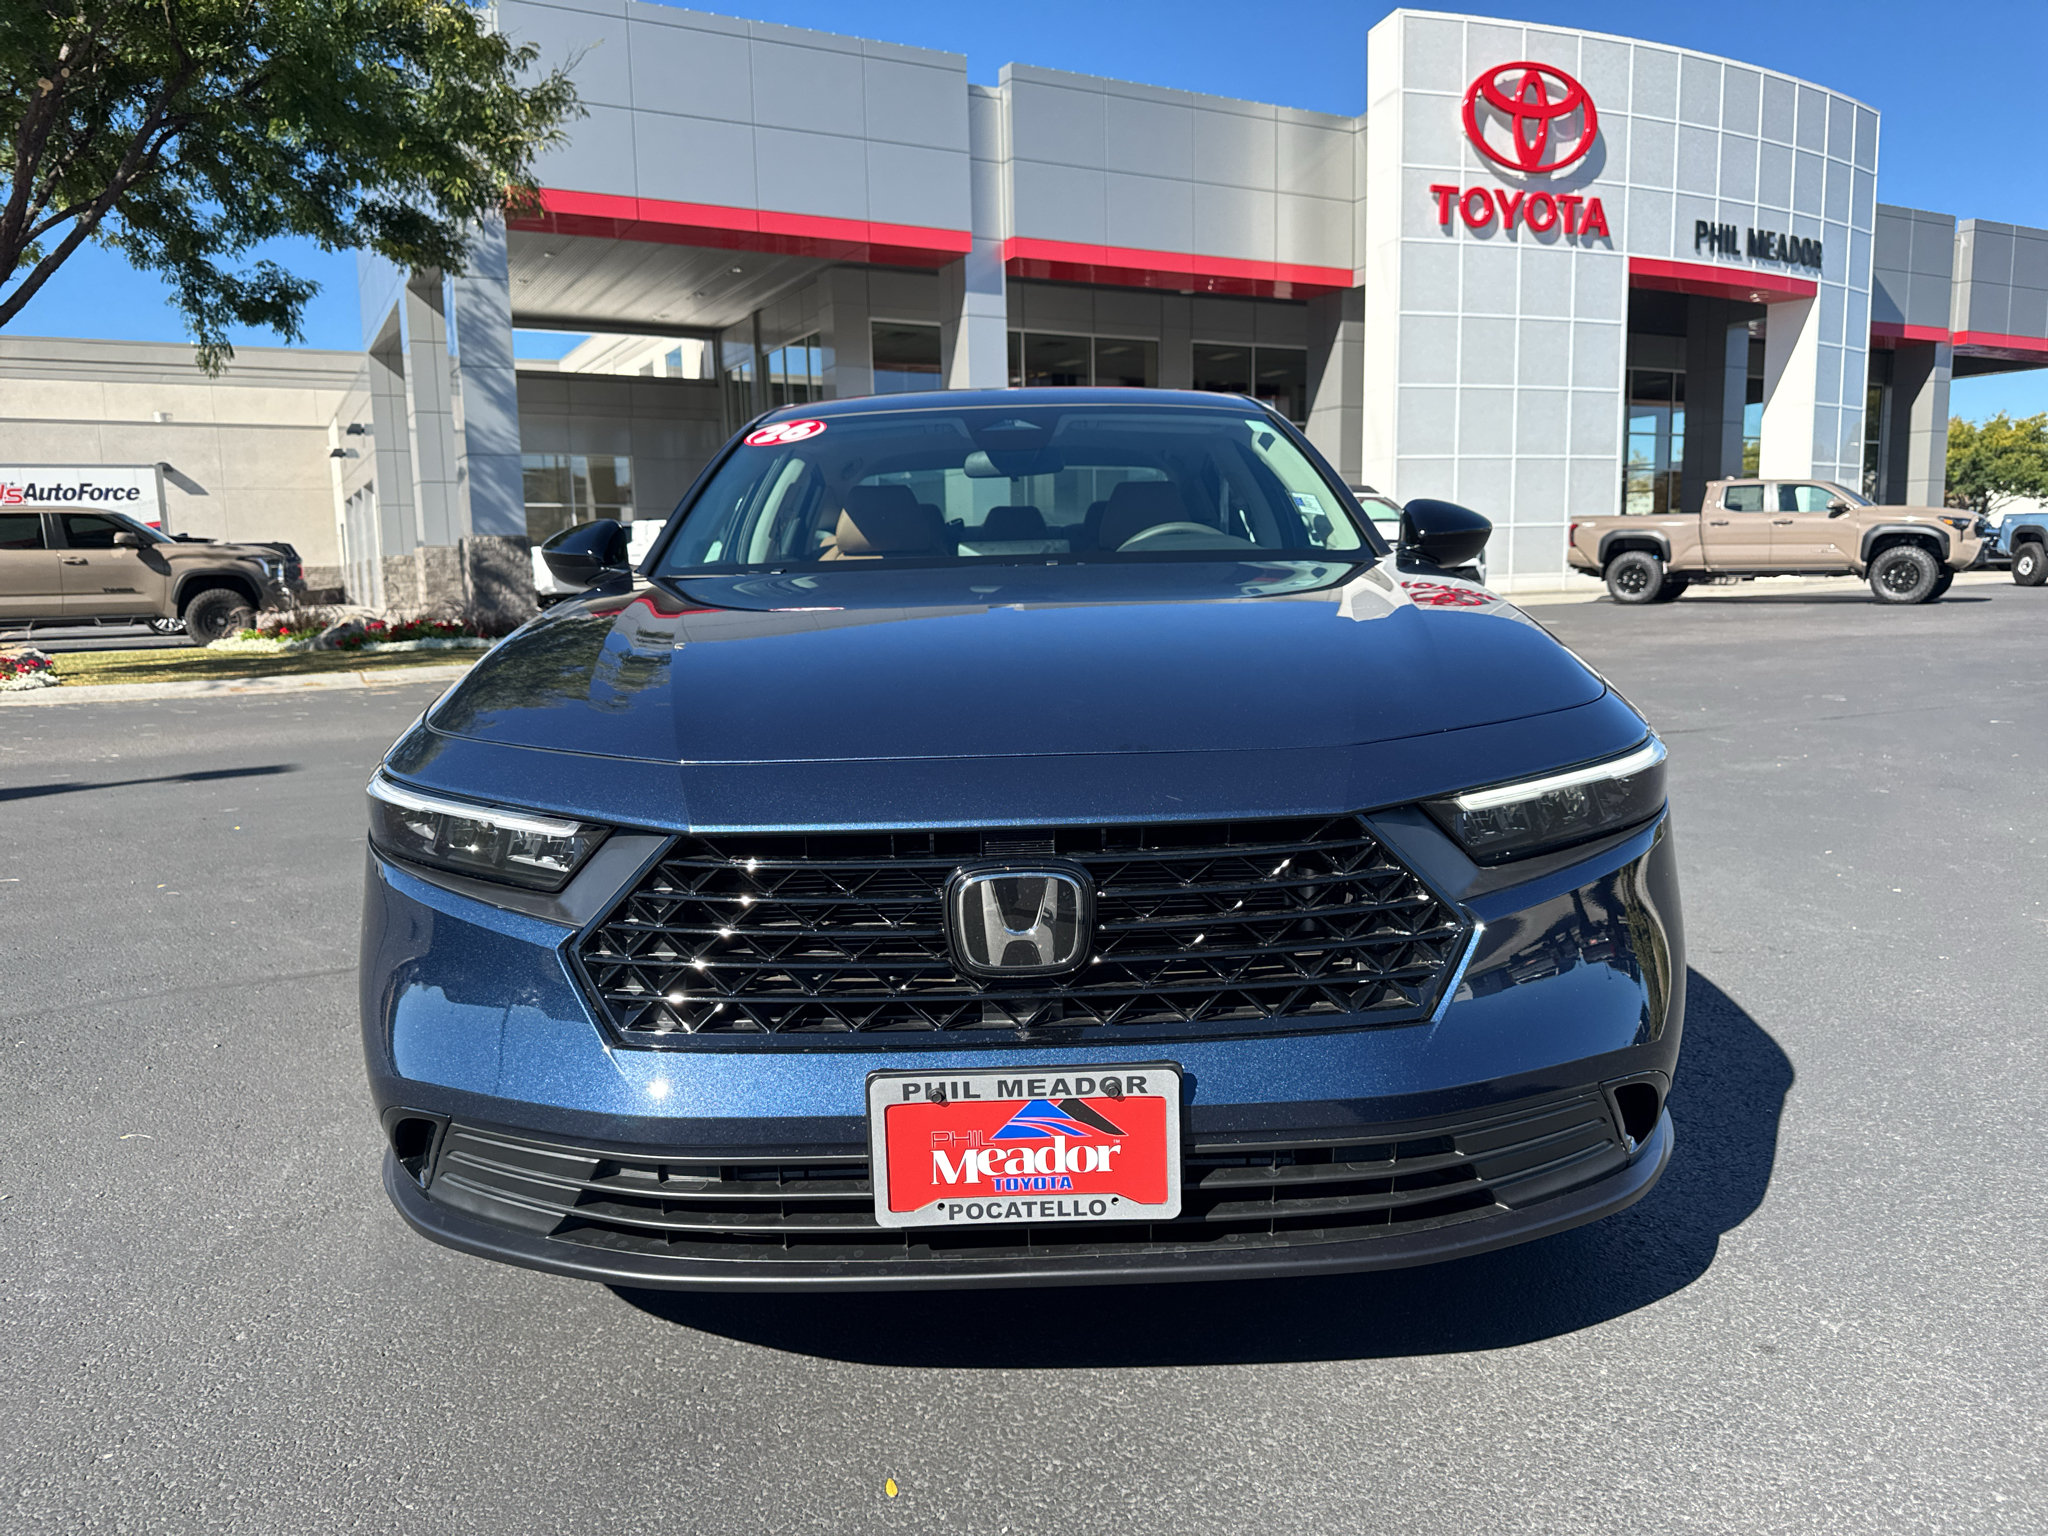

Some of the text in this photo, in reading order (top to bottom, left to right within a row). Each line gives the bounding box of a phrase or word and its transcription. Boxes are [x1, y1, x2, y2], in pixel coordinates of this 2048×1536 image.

[1430, 184, 1610, 237] TOYOTA
[1694, 220, 1823, 269] PHIL MEADOR
[902, 1081, 981, 1101] PHIL
[931, 1130, 996, 1149] PHIL
[930, 1135, 1122, 1185] Meador
[992, 1175, 1074, 1193] TOYOTA
[948, 1199, 1107, 1221] POCATELLO
